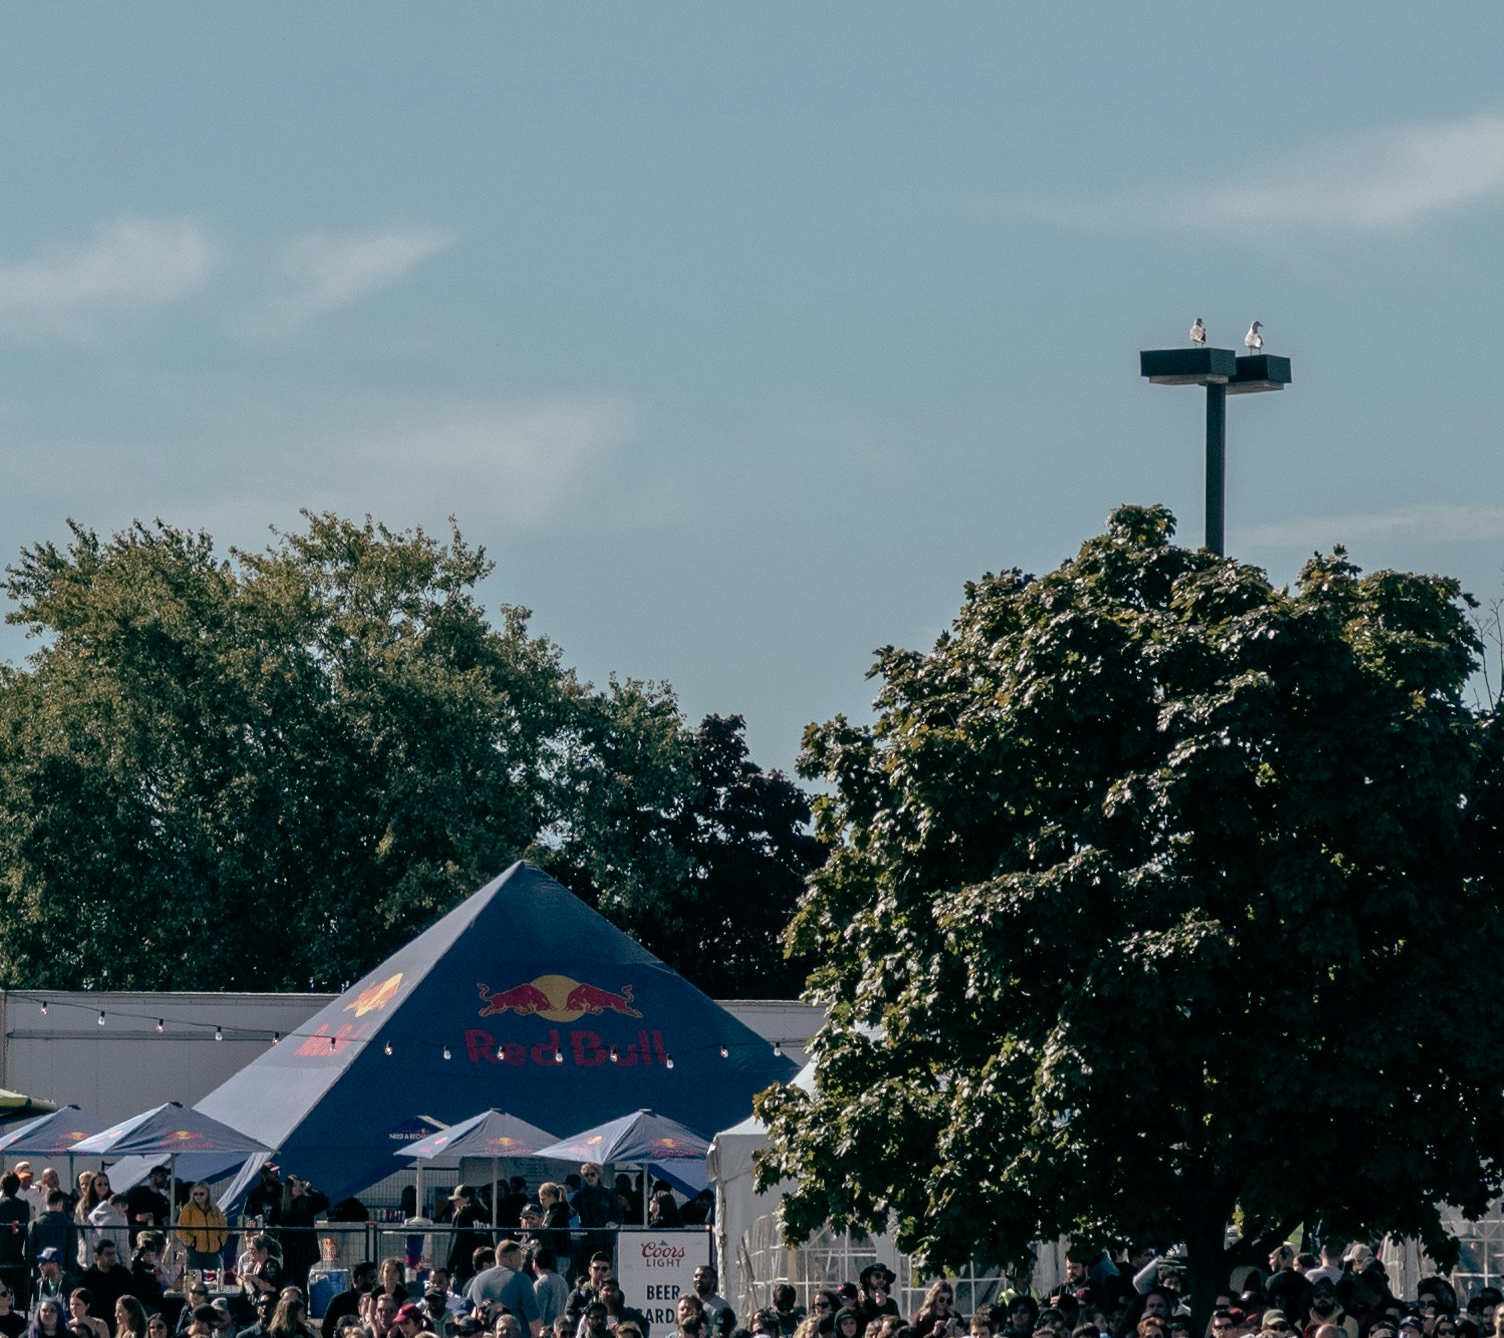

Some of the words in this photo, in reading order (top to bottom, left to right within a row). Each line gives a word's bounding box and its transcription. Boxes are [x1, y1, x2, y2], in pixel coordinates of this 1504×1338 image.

[464, 1028, 560, 1066] Red
[570, 1029, 668, 1067] Bull
[641, 1241, 685, 1259] Coors
[646, 1258, 682, 1268] LIGHT
[646, 1284, 680, 1301] BEER
